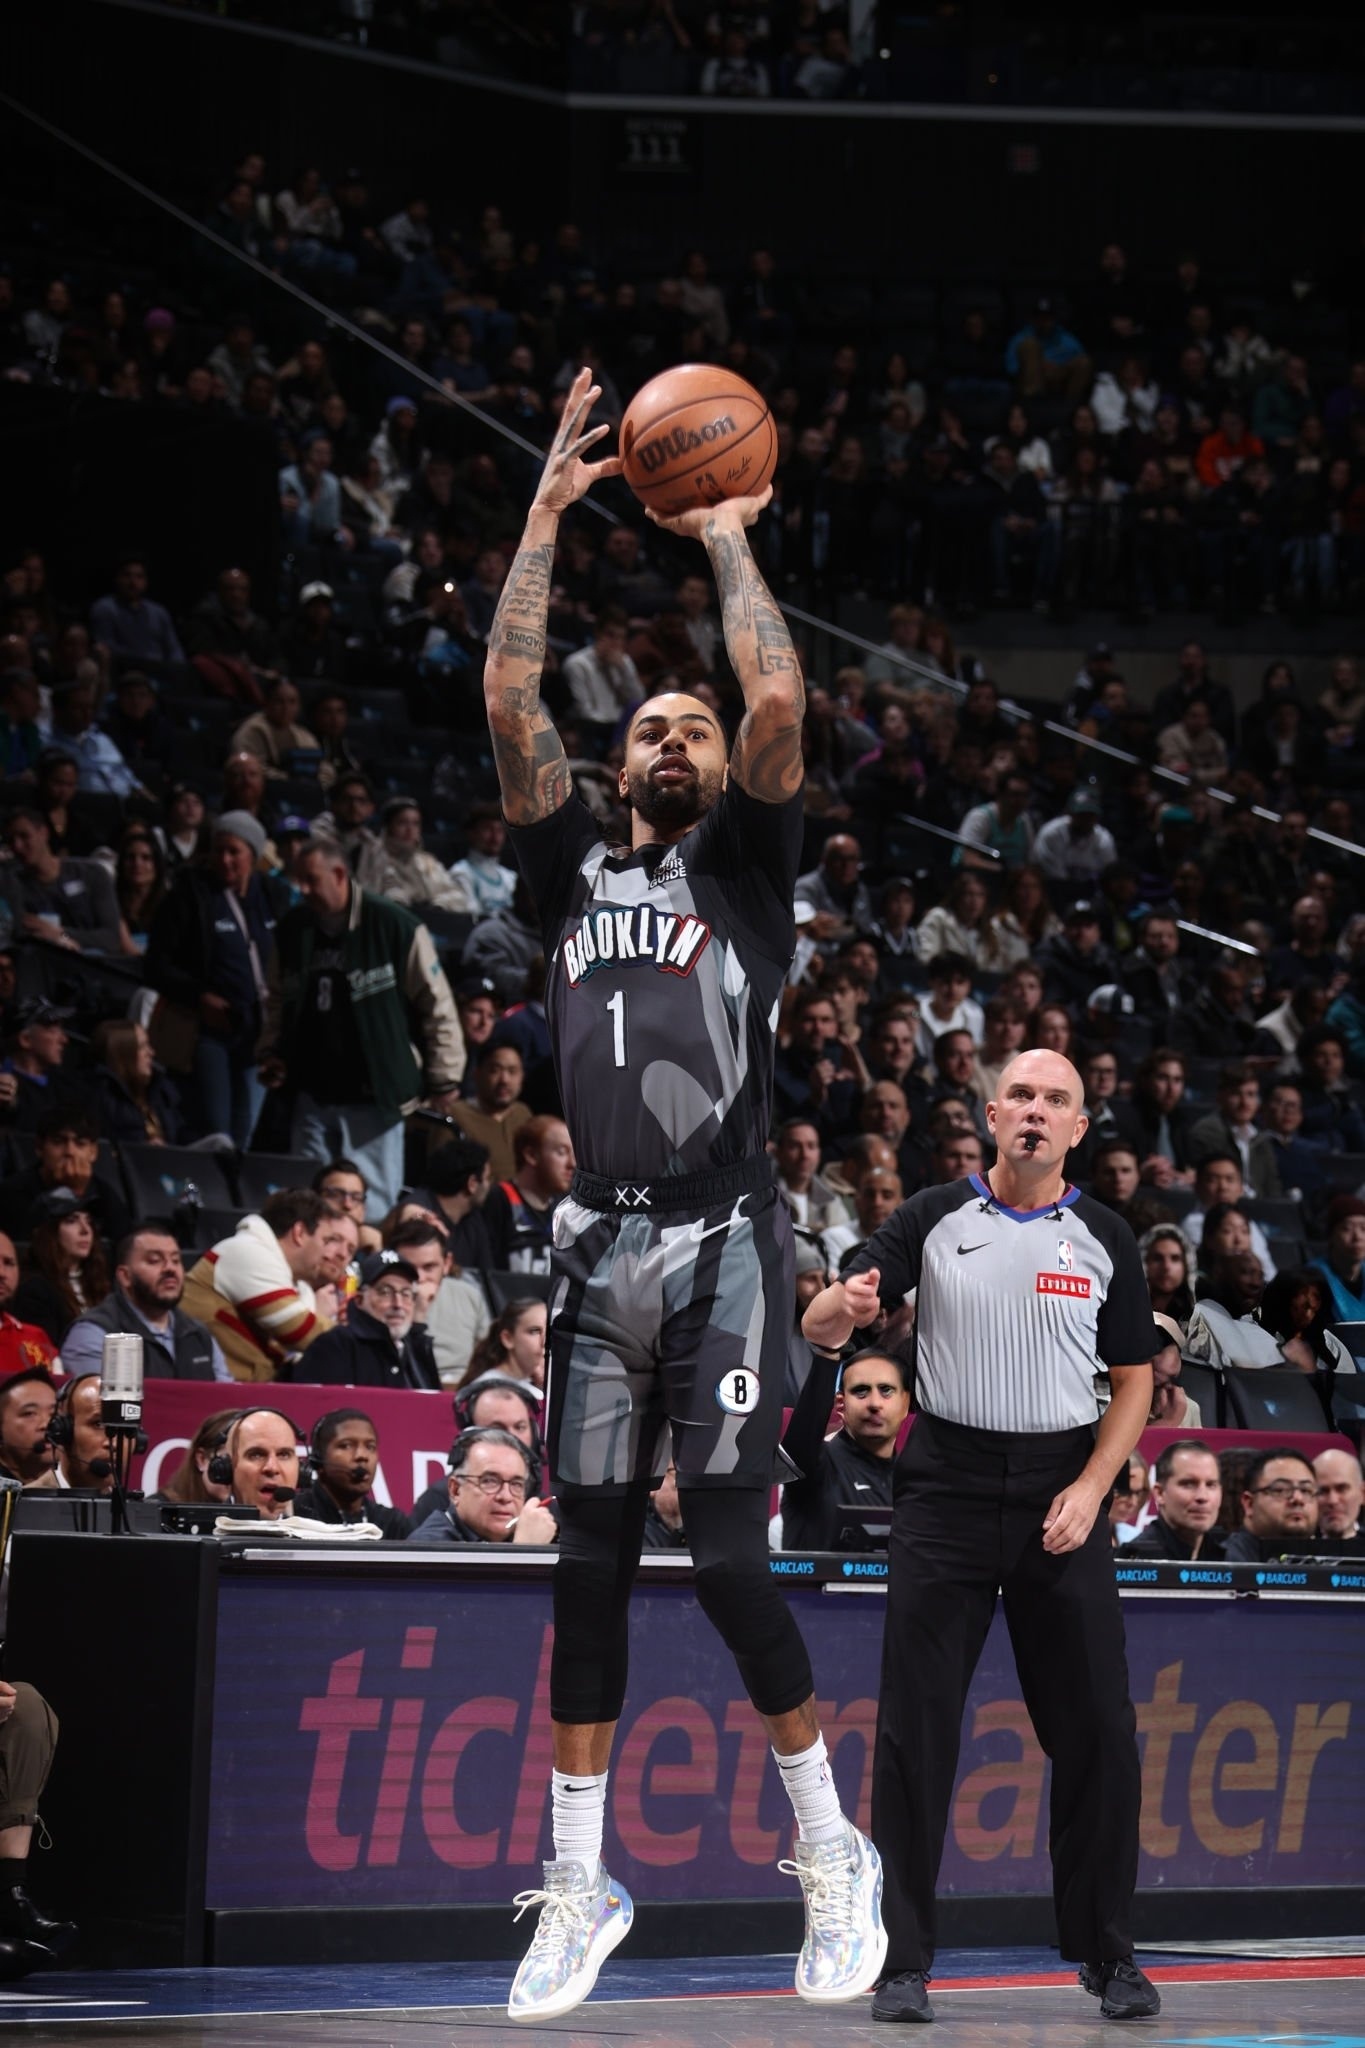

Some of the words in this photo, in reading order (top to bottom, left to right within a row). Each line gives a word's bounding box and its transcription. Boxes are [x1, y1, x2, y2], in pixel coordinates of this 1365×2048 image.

[636, 415, 737, 474] Wilson
[649, 866, 687, 888] GUIDE
[563, 906, 707, 984] BROOKLYN
[606, 990, 626, 1067] 1
[733, 1374, 748, 1405] 8
[1265, 1572, 1308, 1585] BARCLAYS
